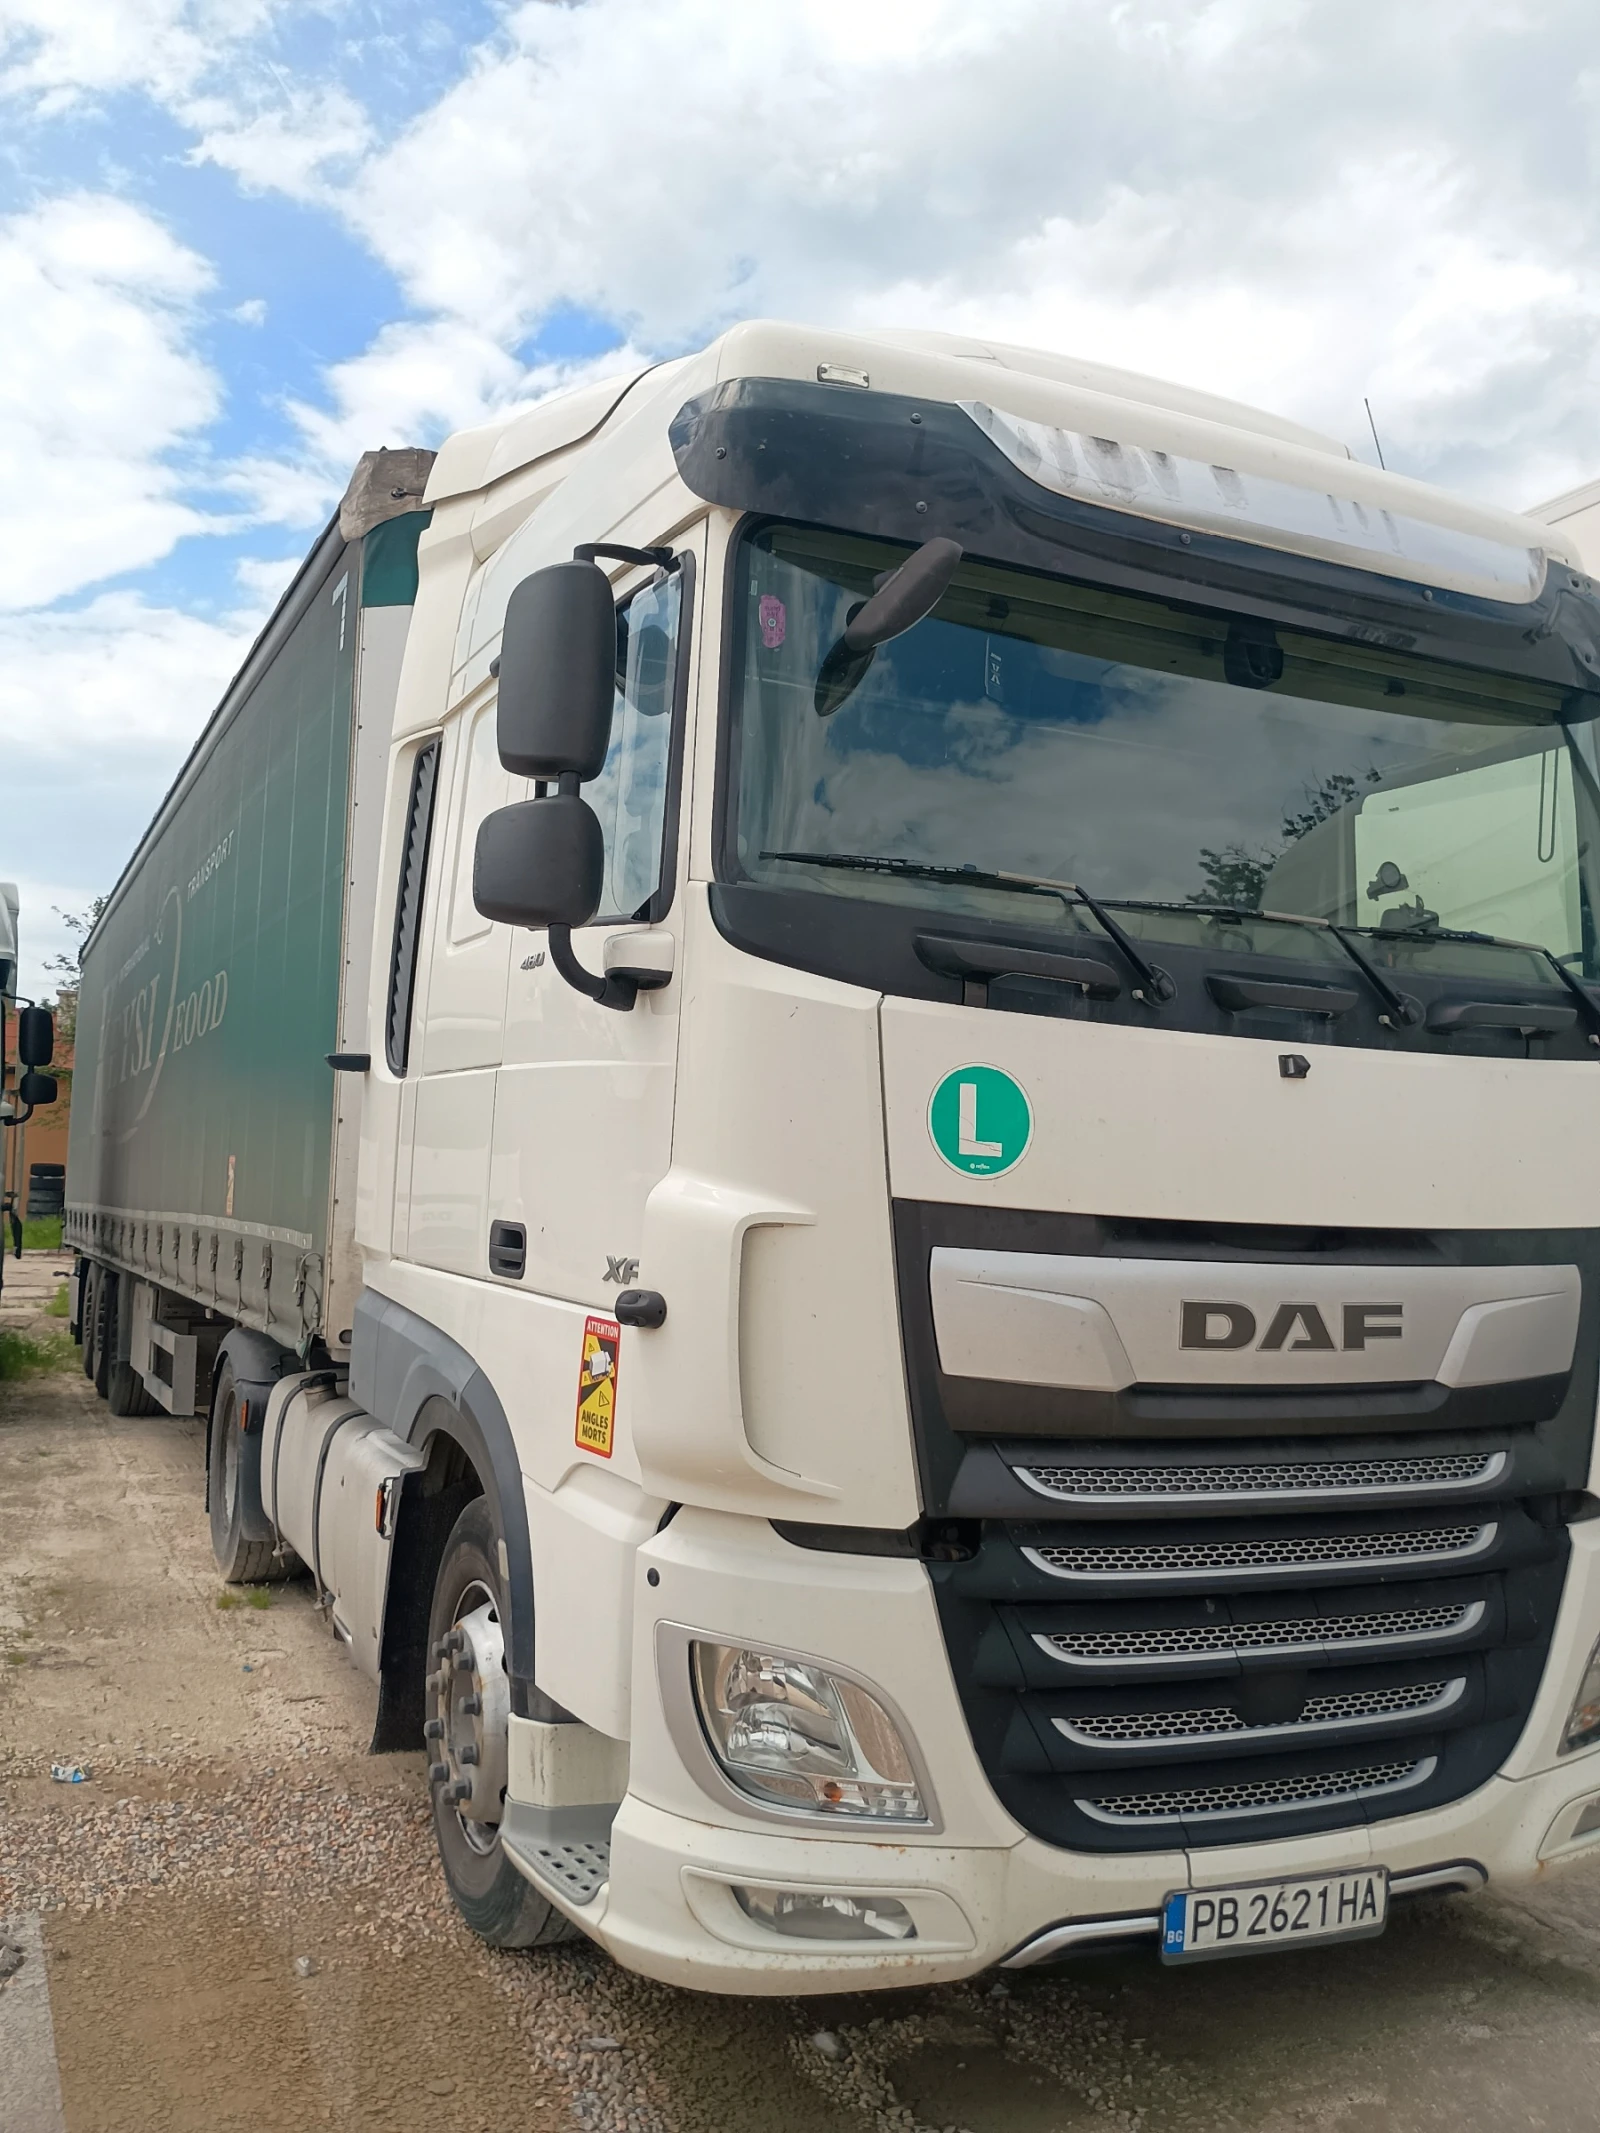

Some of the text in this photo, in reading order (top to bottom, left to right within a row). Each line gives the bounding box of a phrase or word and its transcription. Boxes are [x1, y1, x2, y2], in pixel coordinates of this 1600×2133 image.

[187, 828, 234, 903] TRANSPORT
[172, 970, 228, 1054] EOOD
[958, 1082, 1003, 1158] L
[602, 1255, 640, 1285] XF
[586, 1320, 619, 1339] ATTENTION
[1179, 1299, 1404, 1352] DAF
[581, 1409, 609, 1430] ANGLES
[581, 1427, 607, 1445] MORTS
[1166, 1877, 1377, 1944] BG PB 2621 HA
